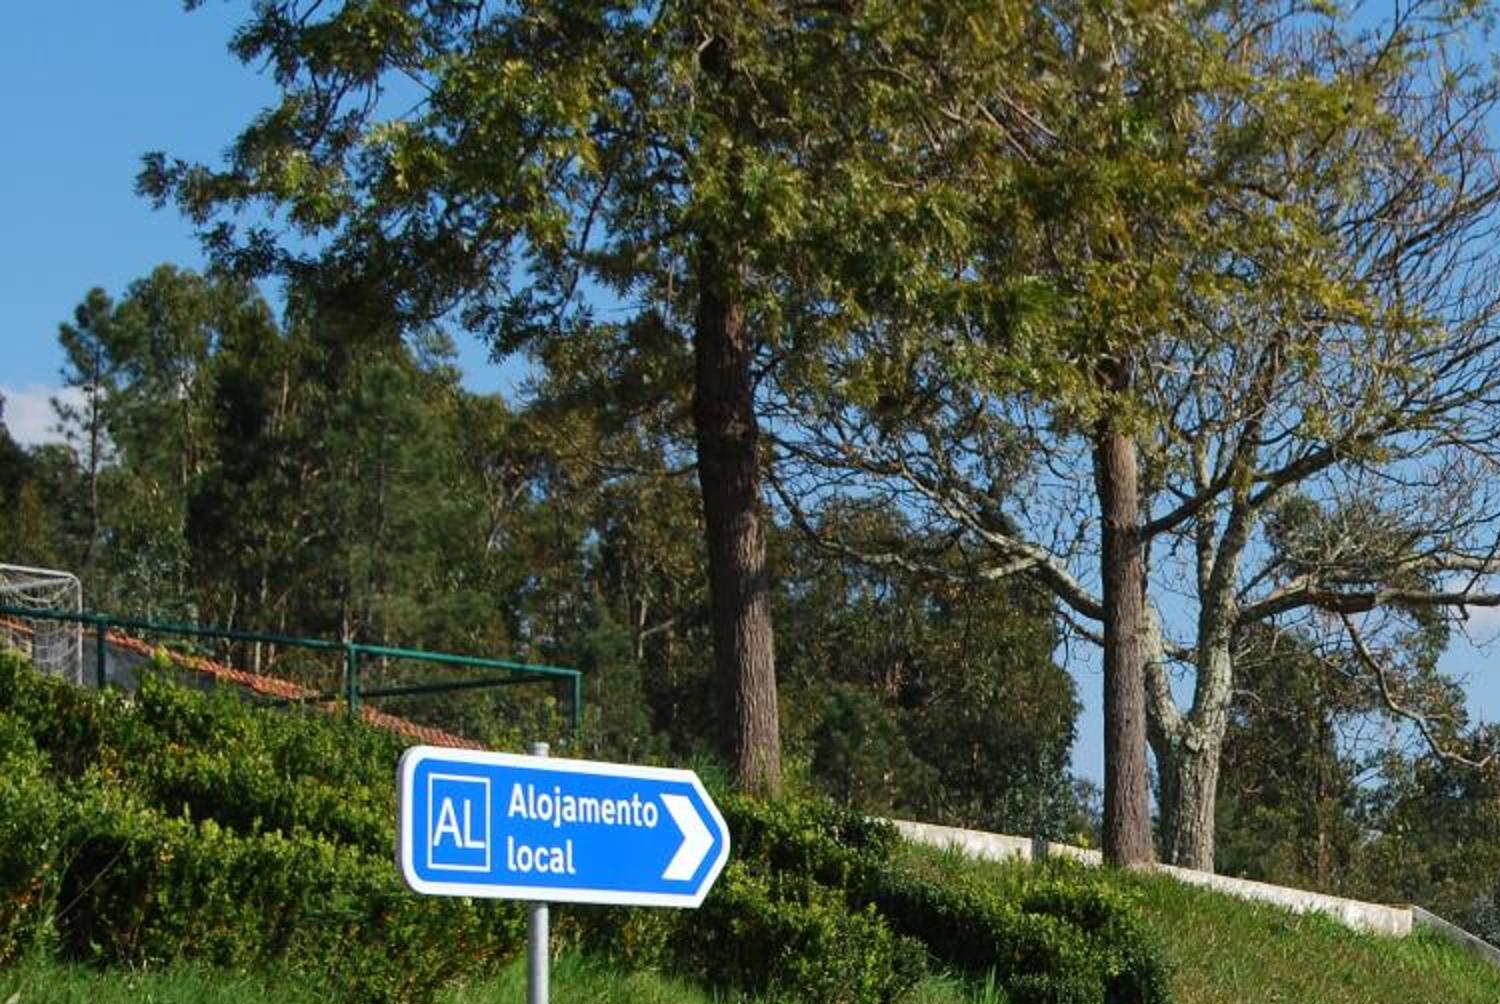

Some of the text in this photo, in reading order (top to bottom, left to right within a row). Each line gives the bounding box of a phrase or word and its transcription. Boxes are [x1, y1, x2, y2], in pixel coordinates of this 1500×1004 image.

[432, 797, 486, 849] AL
[507, 783, 659, 828] Alojamento
[506, 836, 576, 875] local
